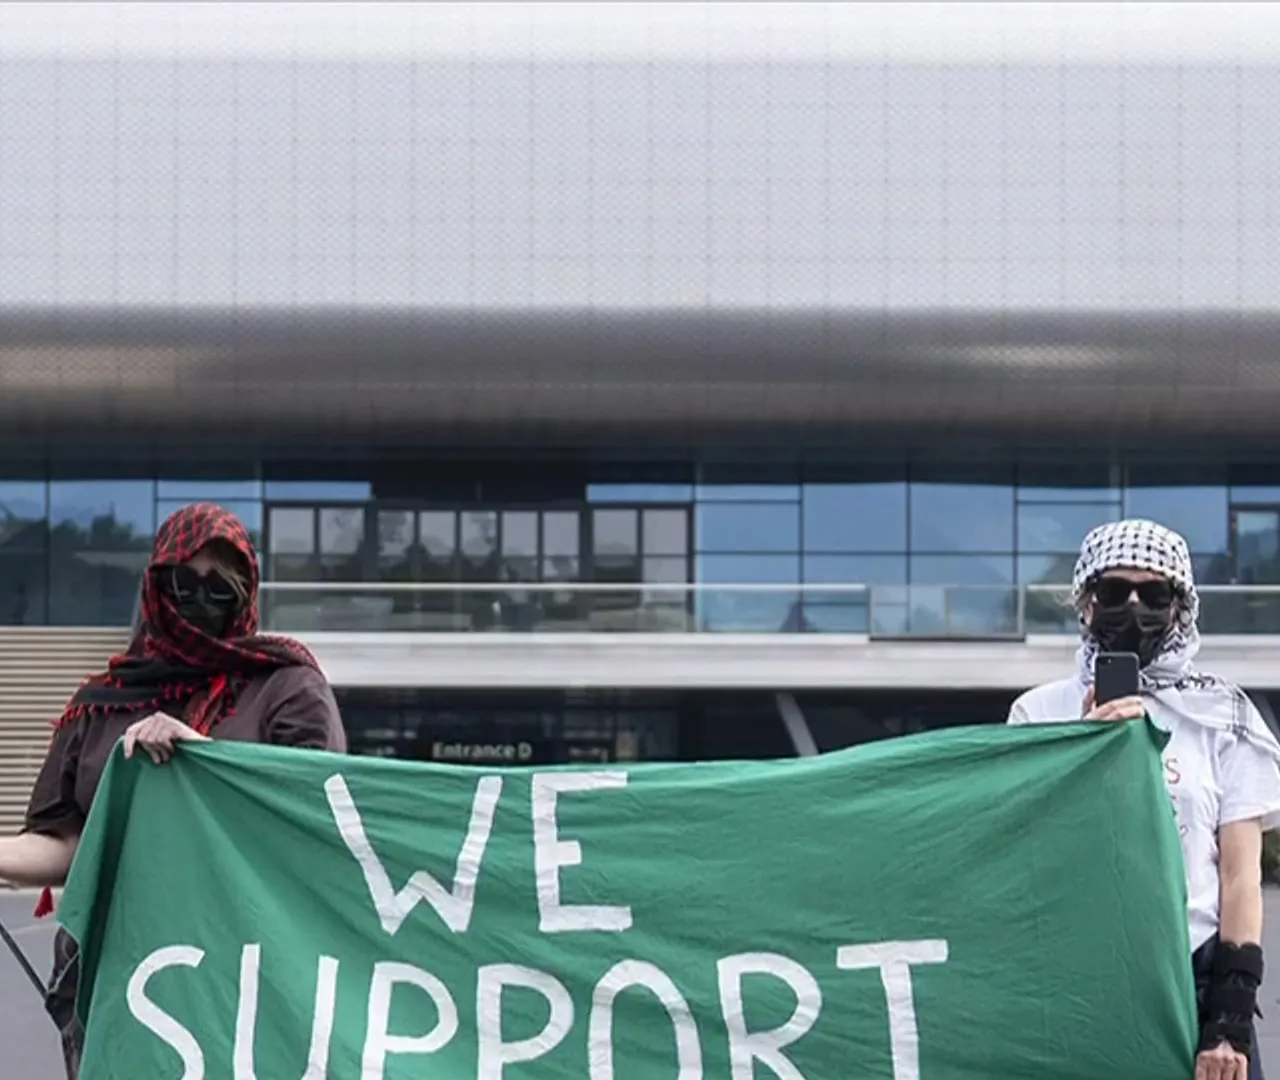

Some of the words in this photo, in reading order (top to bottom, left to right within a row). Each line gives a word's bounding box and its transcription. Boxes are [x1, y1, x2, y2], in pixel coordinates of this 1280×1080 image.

[431, 741, 516, 760] Entrance
[519, 742, 533, 760] D
[324, 771, 632, 934] WE
